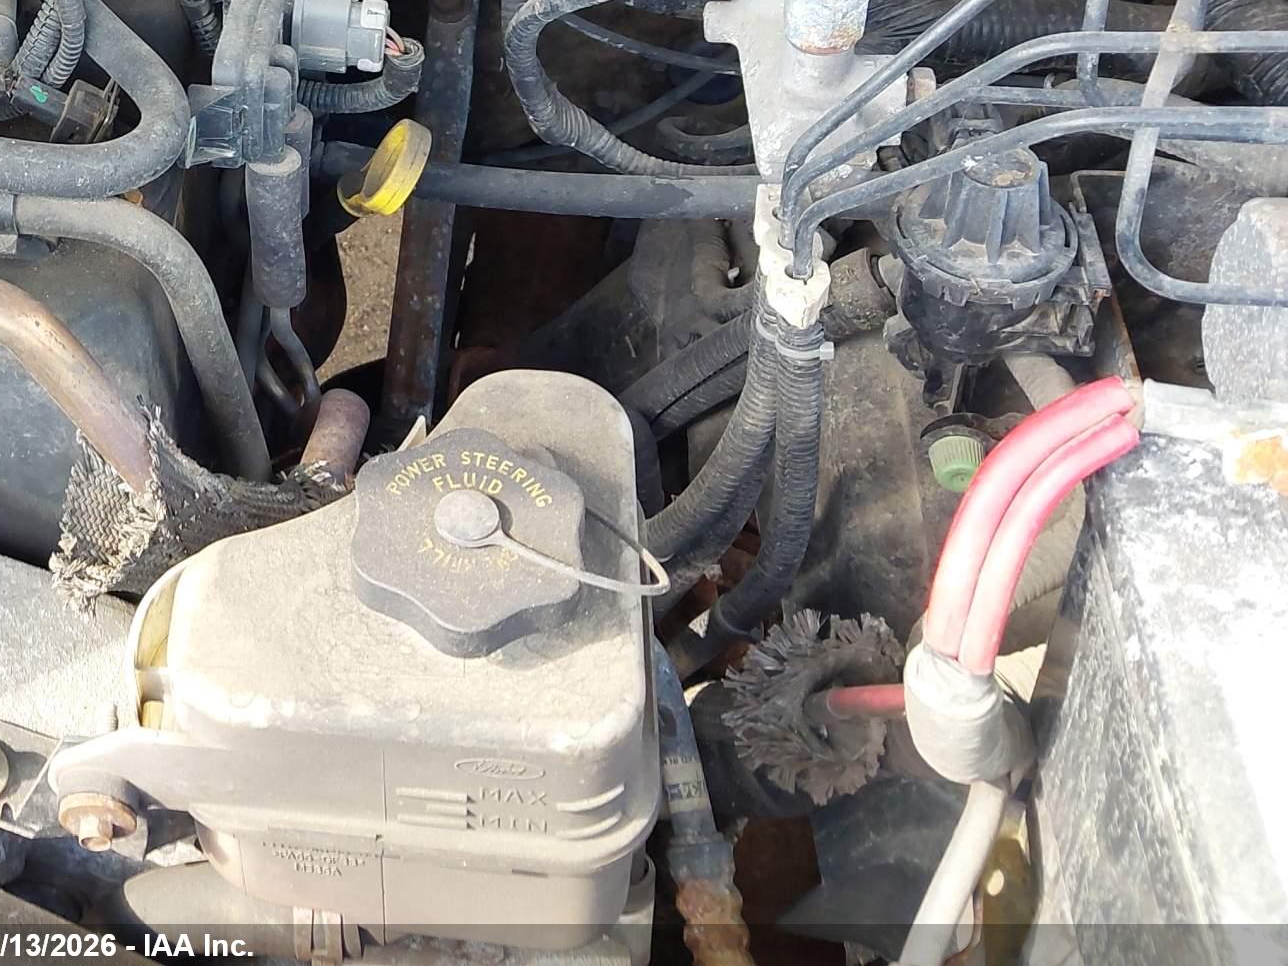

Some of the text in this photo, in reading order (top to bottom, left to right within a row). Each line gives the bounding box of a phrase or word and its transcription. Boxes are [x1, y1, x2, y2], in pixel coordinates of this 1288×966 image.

[386, 450, 554, 508] POWER STEERING
[431, 471, 503, 495] FLUID
[479, 785, 548, 806] MAX
[479, 813, 548, 834] MIN
